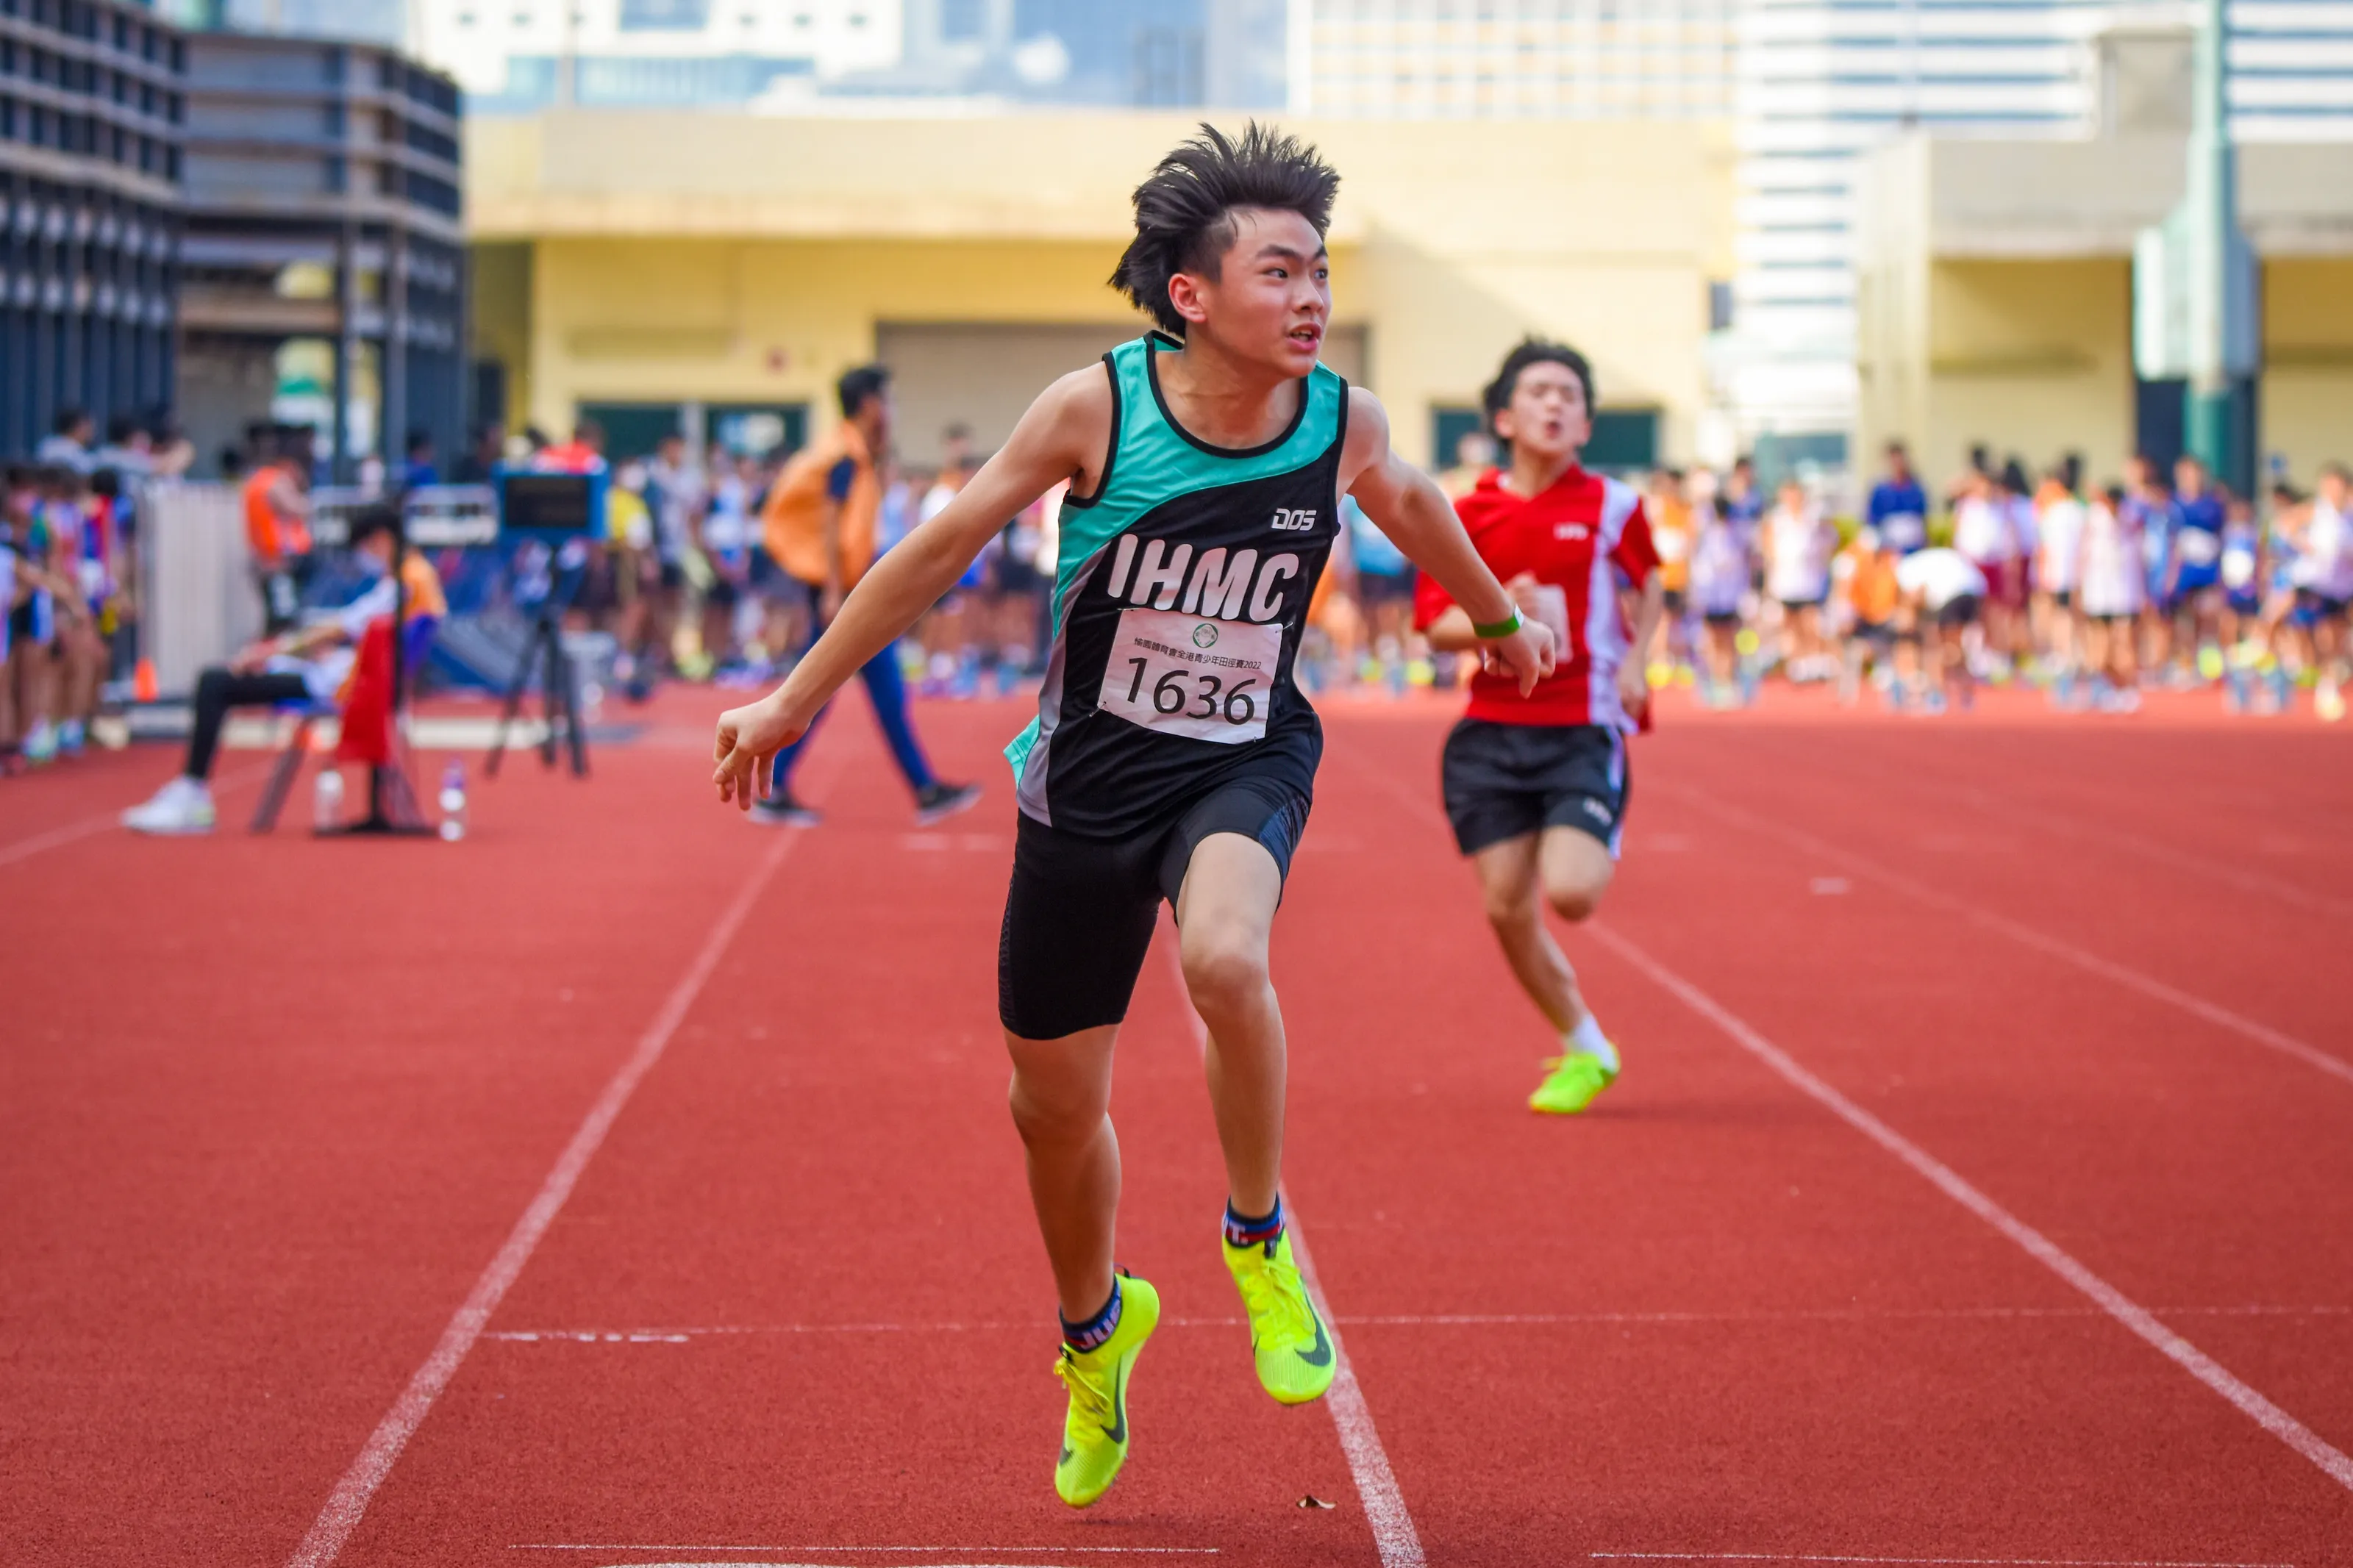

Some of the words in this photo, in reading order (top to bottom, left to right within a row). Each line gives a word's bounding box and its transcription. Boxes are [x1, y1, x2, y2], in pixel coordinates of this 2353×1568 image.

[1271, 508, 1317, 531] DOS
[1107, 534, 1299, 622] IHMC
[1127, 657, 1257, 726] 1636
